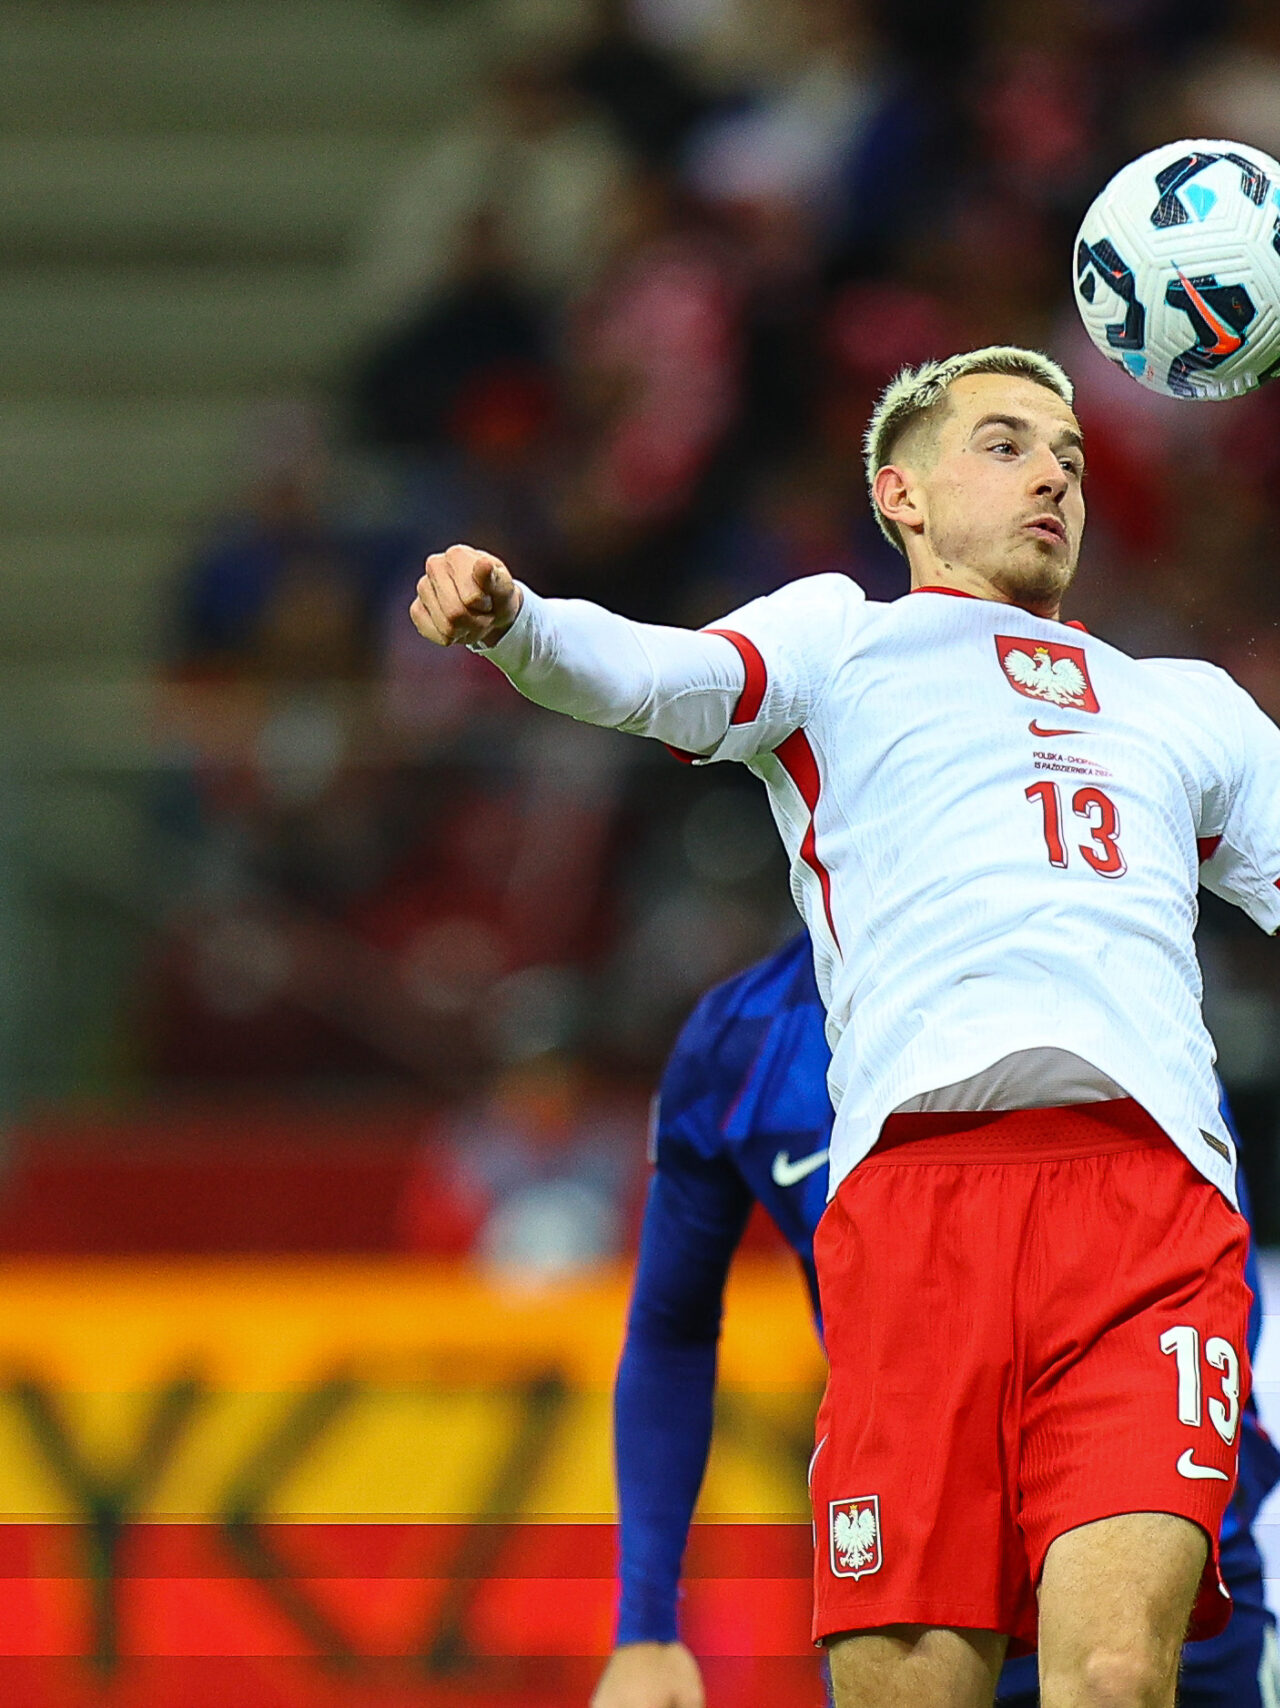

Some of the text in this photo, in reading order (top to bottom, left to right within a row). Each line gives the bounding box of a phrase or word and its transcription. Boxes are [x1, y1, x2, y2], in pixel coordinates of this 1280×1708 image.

[1032, 751, 1063, 762] POLSKA
[1024, 781, 1128, 880] 13
[1159, 1325, 1241, 1446] 13
